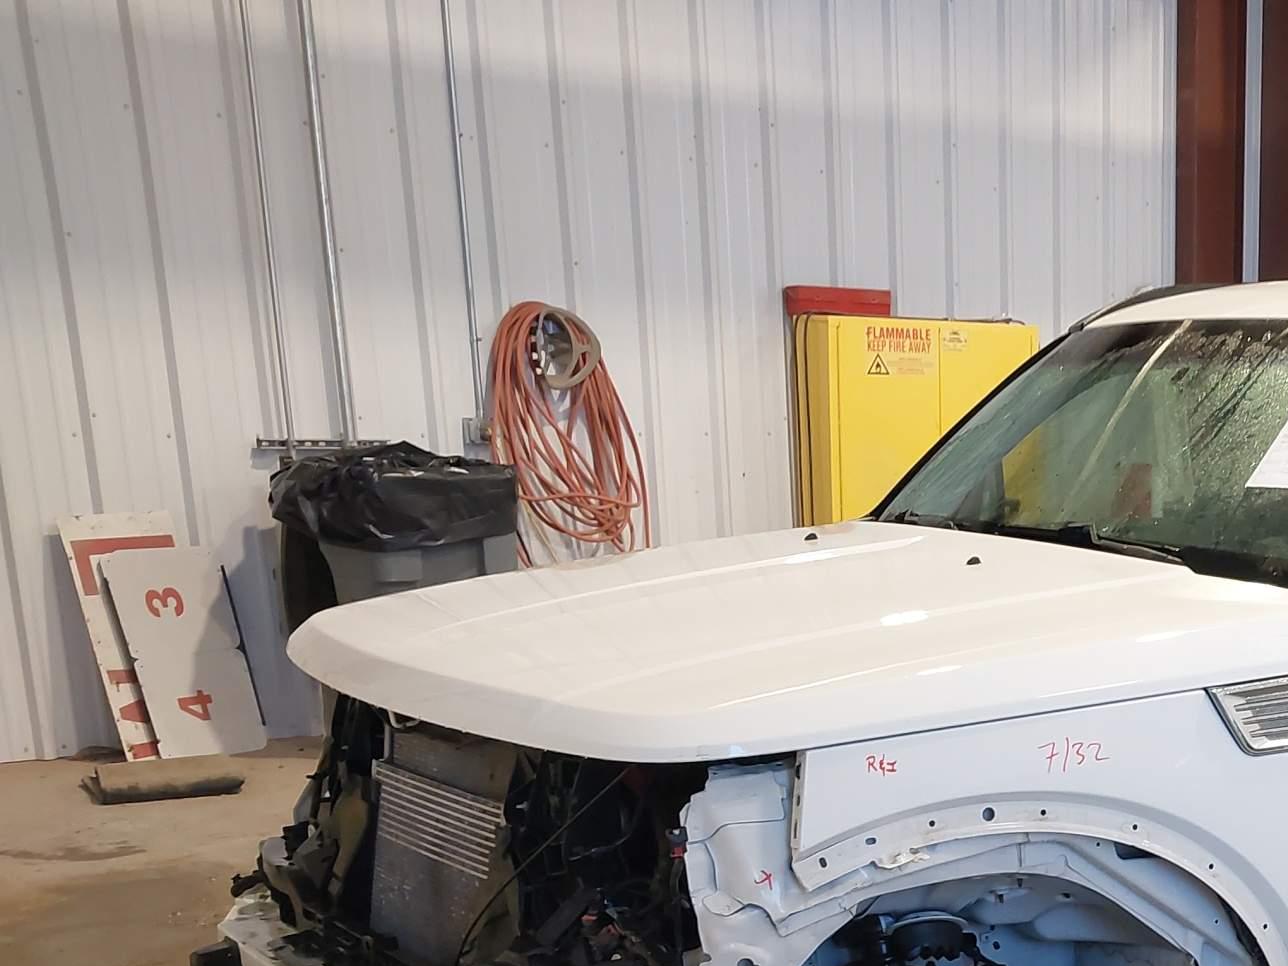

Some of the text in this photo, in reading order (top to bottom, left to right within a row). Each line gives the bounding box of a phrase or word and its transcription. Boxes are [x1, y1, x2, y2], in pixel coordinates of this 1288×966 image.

[866, 326, 932, 341] FLAMMABLE
[867, 339, 887, 352] KEEP
[888, 340, 906, 353] FIRE
[908, 341, 932, 354] AWAY
[144, 587, 185, 618] 3
[177, 689, 214, 721] 4
[1037, 736, 1110, 774] 7/32
